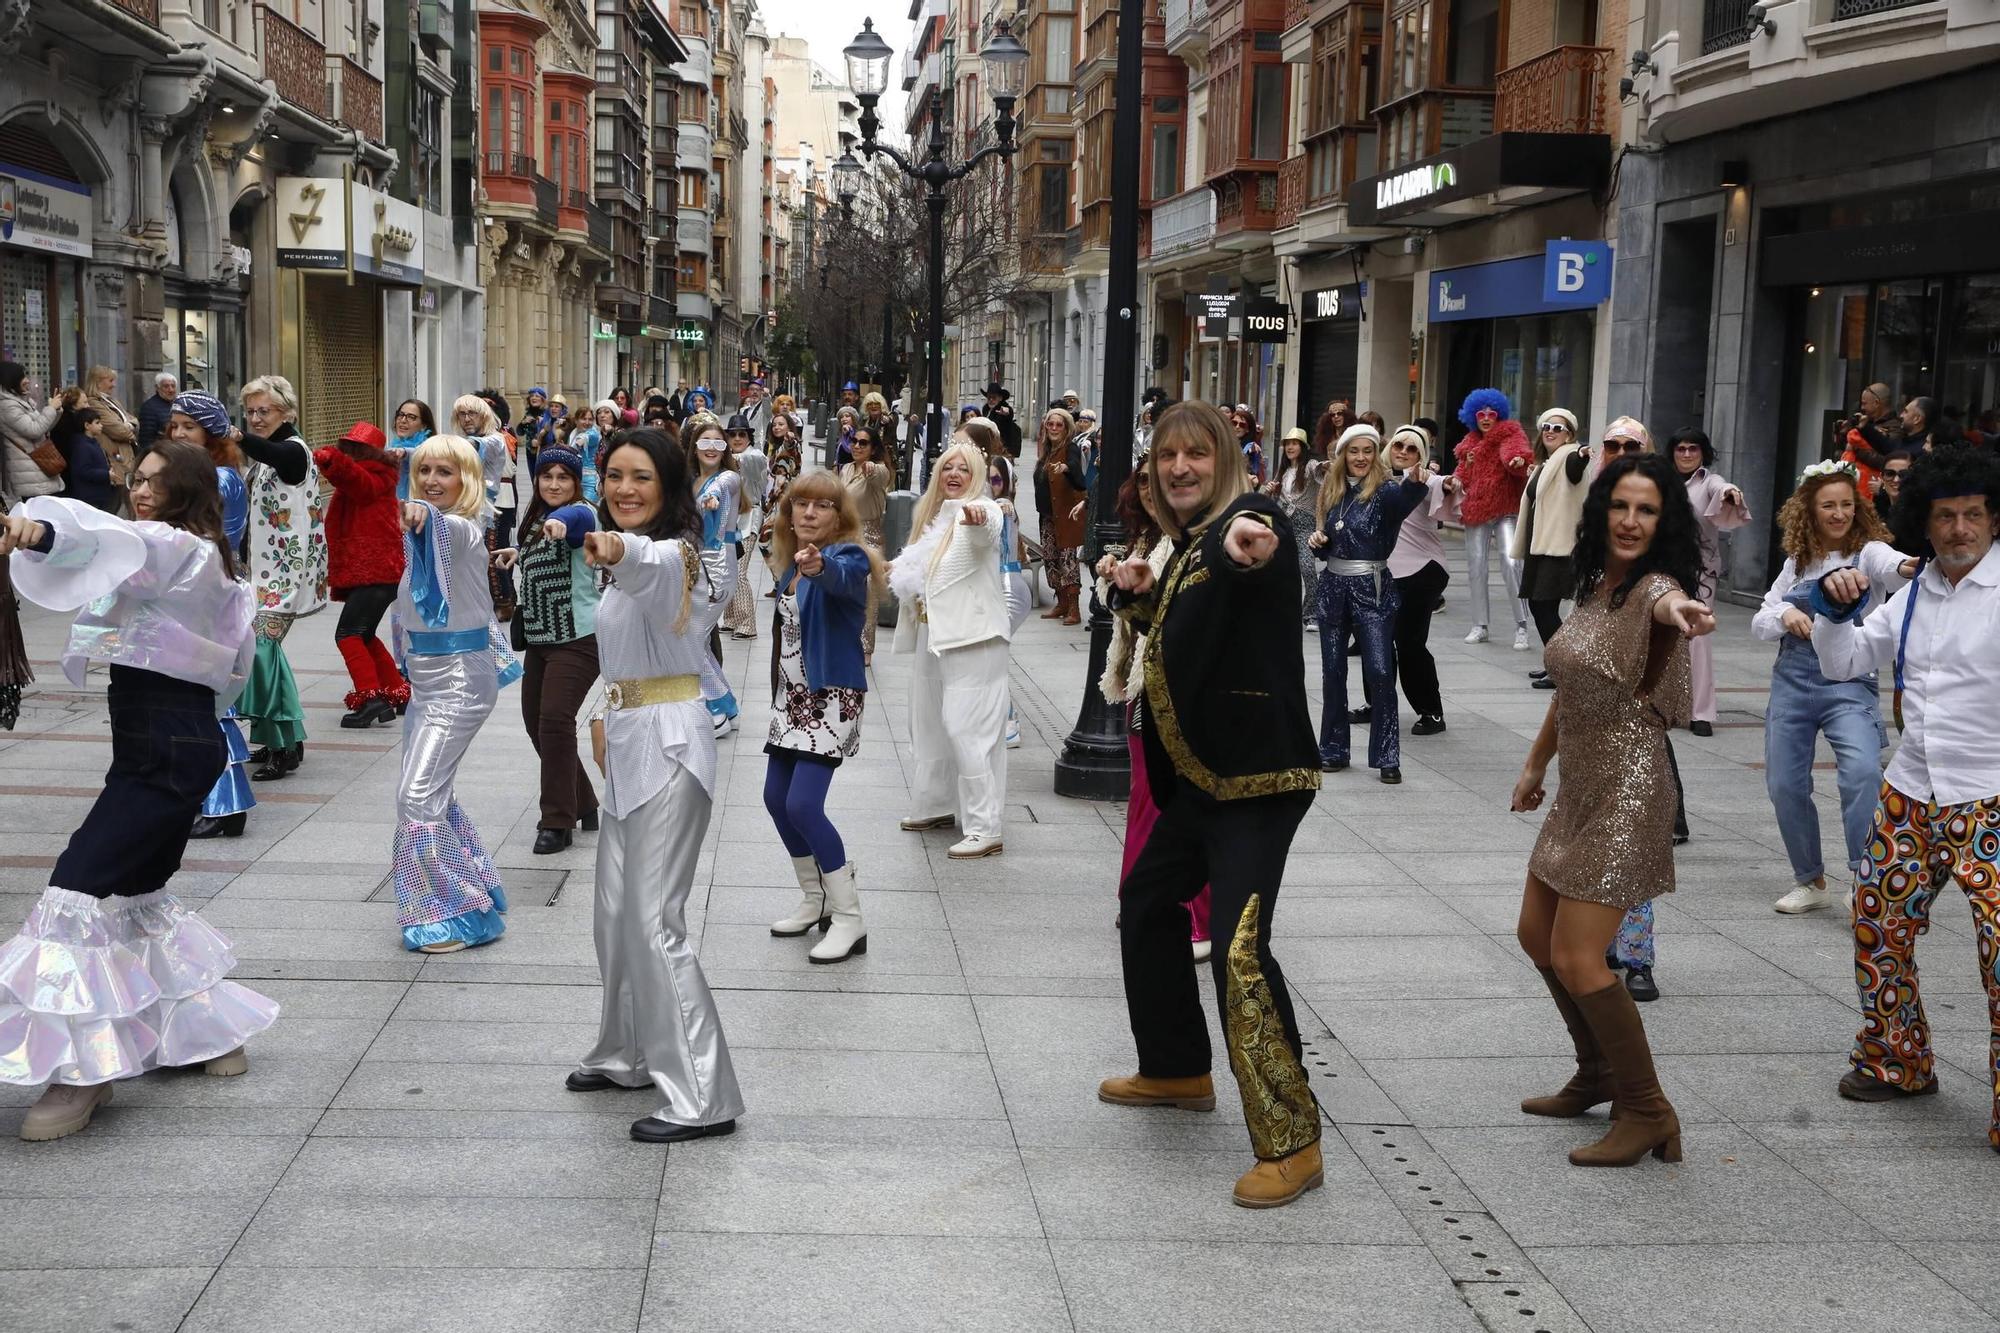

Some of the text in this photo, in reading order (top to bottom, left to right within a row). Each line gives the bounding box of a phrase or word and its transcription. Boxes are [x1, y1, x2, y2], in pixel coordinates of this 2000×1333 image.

[1557, 253, 1584, 292] B
[1317, 289, 1339, 317] TOUS
[1248, 316, 1285, 330] TOUS
[676, 330, 704, 340] 11:12
